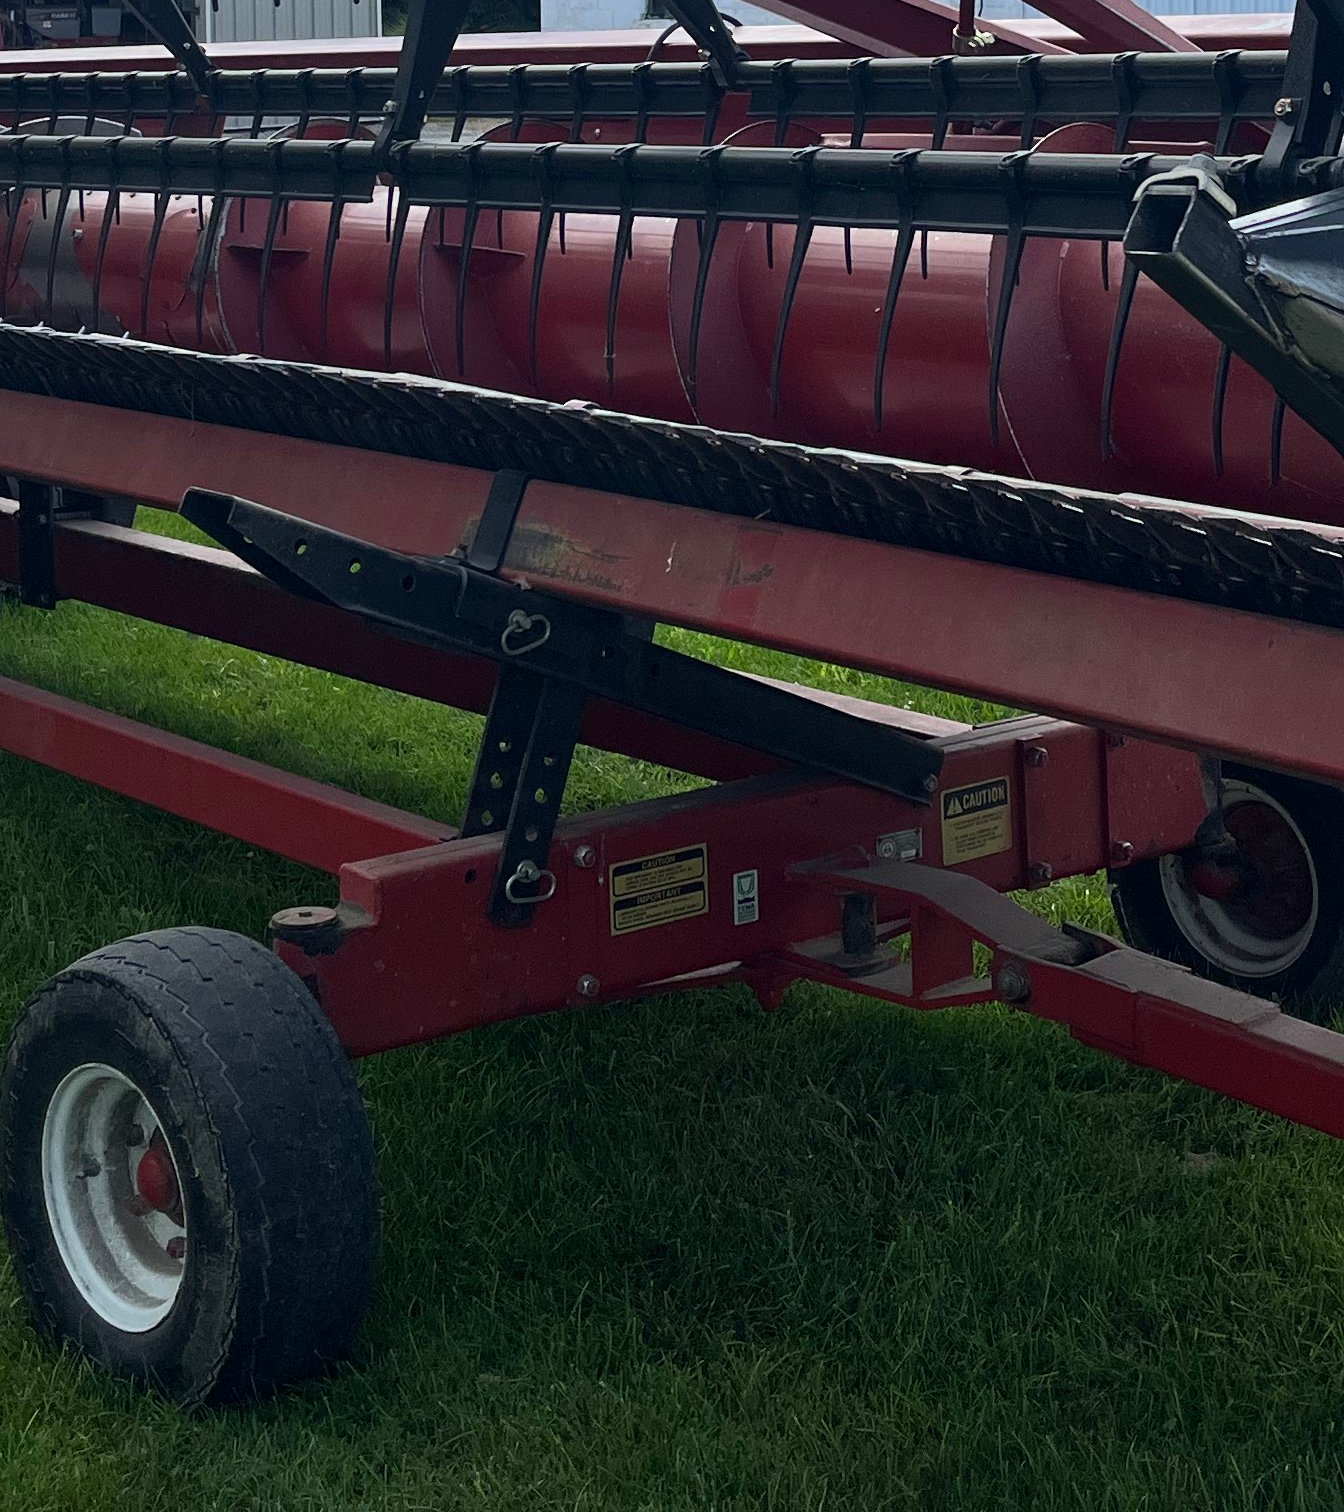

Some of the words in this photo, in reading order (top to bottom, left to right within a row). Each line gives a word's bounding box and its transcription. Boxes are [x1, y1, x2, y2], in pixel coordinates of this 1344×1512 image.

[962, 784, 1006, 810] CAUTION
[641, 855, 676, 869] CAUTION
[637, 888, 681, 905] IMPORTANT
